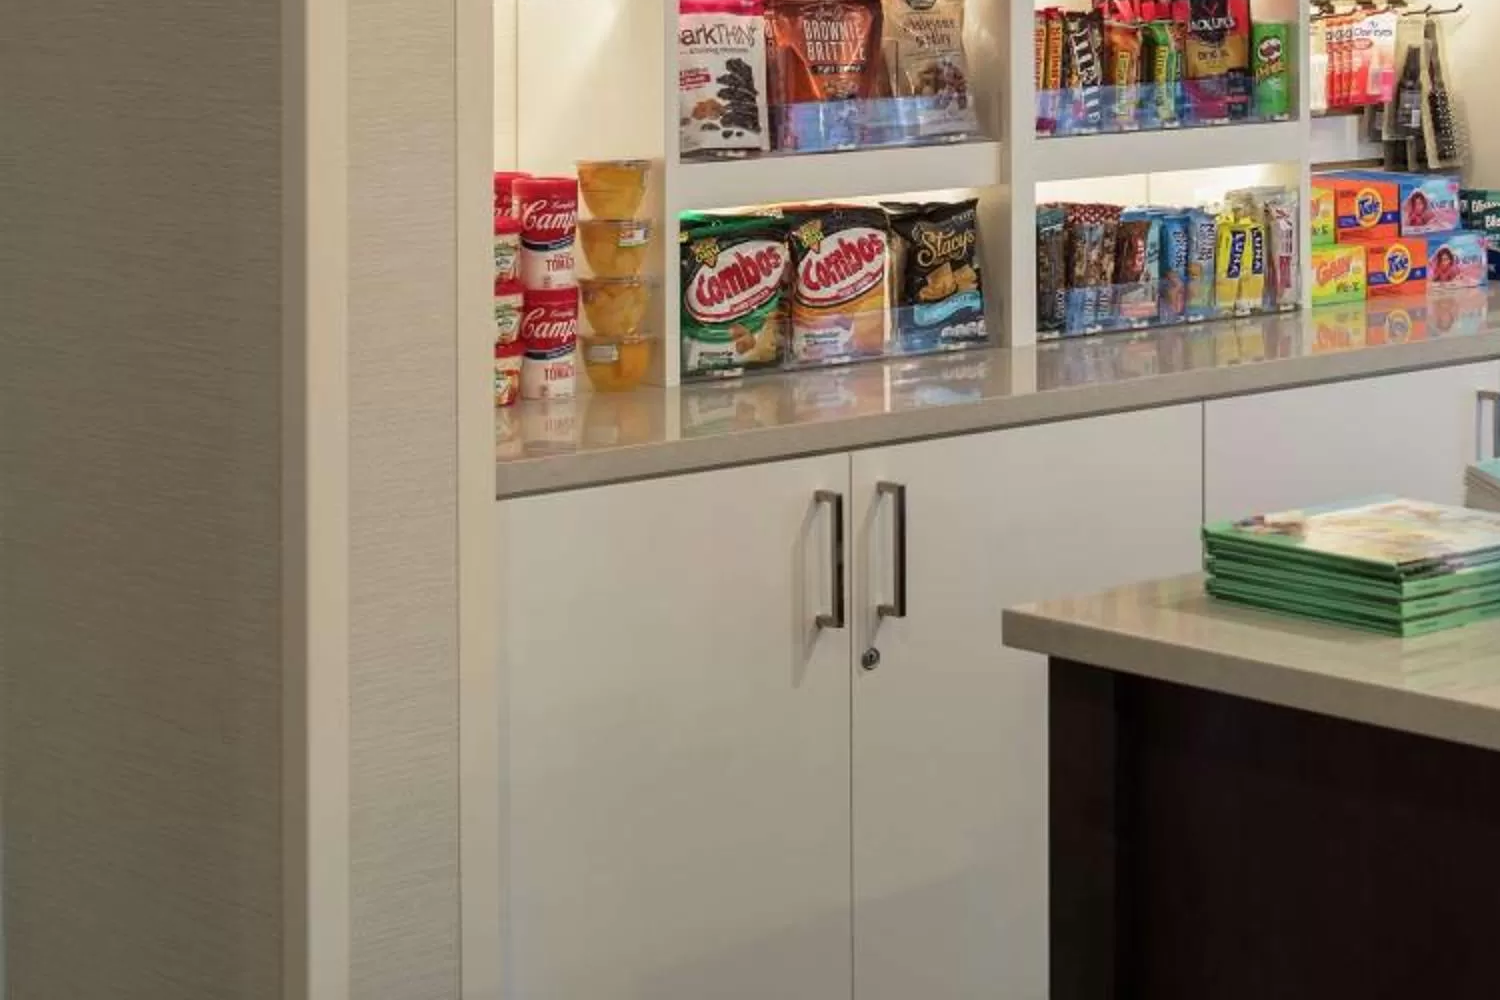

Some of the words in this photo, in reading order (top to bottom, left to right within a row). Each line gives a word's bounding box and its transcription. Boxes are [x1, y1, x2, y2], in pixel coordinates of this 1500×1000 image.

[803, 18, 867, 41] BROWNIE
[806, 40, 867, 63] BRITTLE
[801, 233, 887, 291] Combos
[916, 229, 976, 267] Stacy's
[696, 245, 783, 306] Combos
